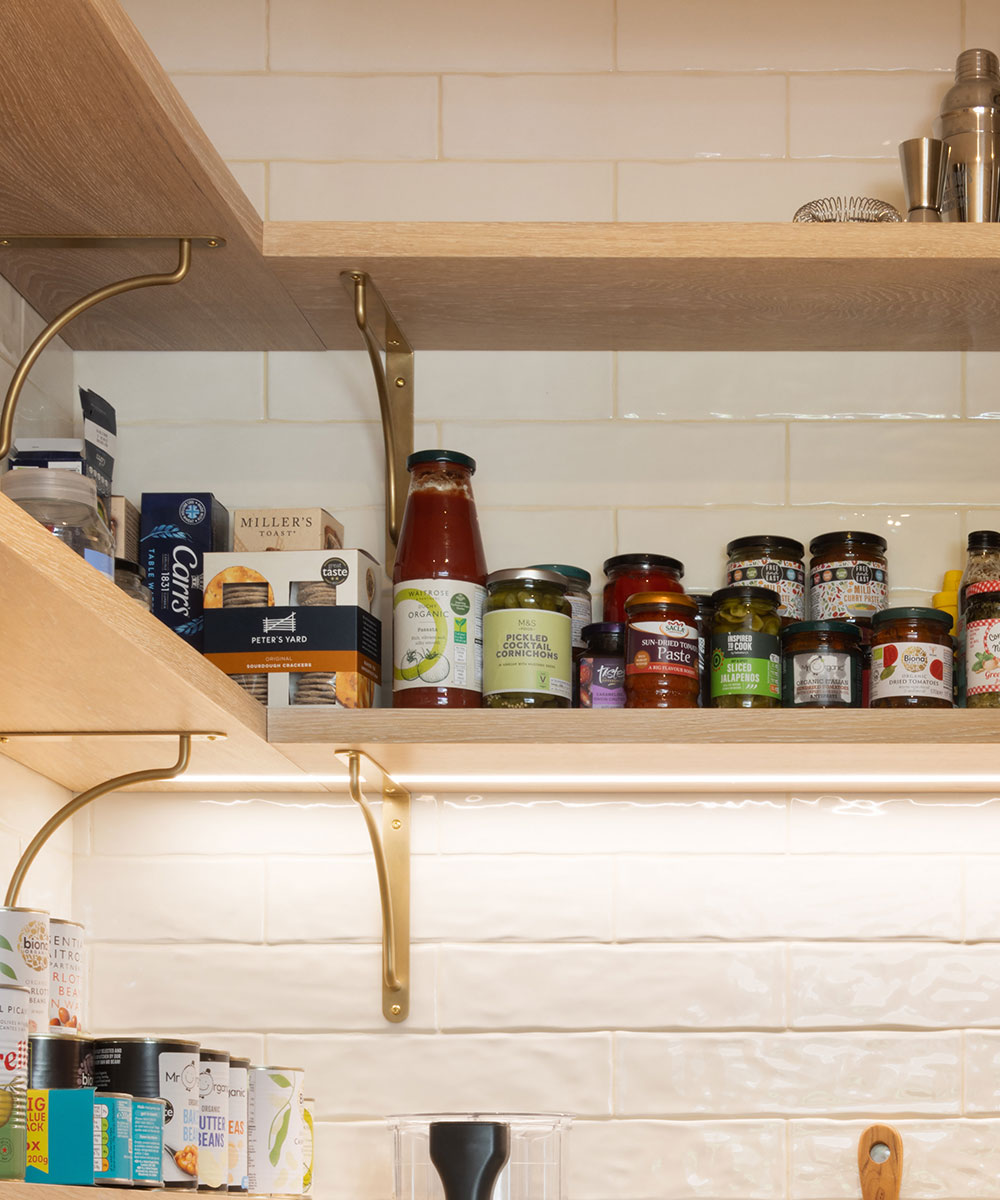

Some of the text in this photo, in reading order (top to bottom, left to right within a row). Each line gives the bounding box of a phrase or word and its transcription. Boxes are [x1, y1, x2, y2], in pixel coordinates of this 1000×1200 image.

[240, 516, 313, 528] MILLER'S
[147, 548, 156, 585] TABLE
[322, 566, 348, 577] taste
[160, 571, 170, 592] 1831
[171, 544, 198, 617] Carr's
[408, 589, 449, 598] WAITROSE
[854, 584, 871, 594] MILD
[844, 595, 880, 603] CURRY PASTE
[408, 610, 449, 619] ORGANIC
[518, 618, 536, 627] M&S
[251, 635, 308, 644] PETER'S YARD
[505, 633, 548, 643] PICKLED
[641, 638, 680, 648] SUN-DRIED
[727, 634, 753, 644] INSPIRED
[502, 641, 551, 651] COCKTAIL
[734, 642, 753, 651] COOK
[495, 649, 559, 660] CORNICHONS
[657, 647, 692, 664] Paste
[661, 665, 683, 673] FLAVOUR
[727, 663, 753, 673] SLICED
[888, 679, 940, 688] DRIED TOMATOES
[165, 1071, 180, 1083] Mr
[199, 1115, 226, 1131] UTTER
